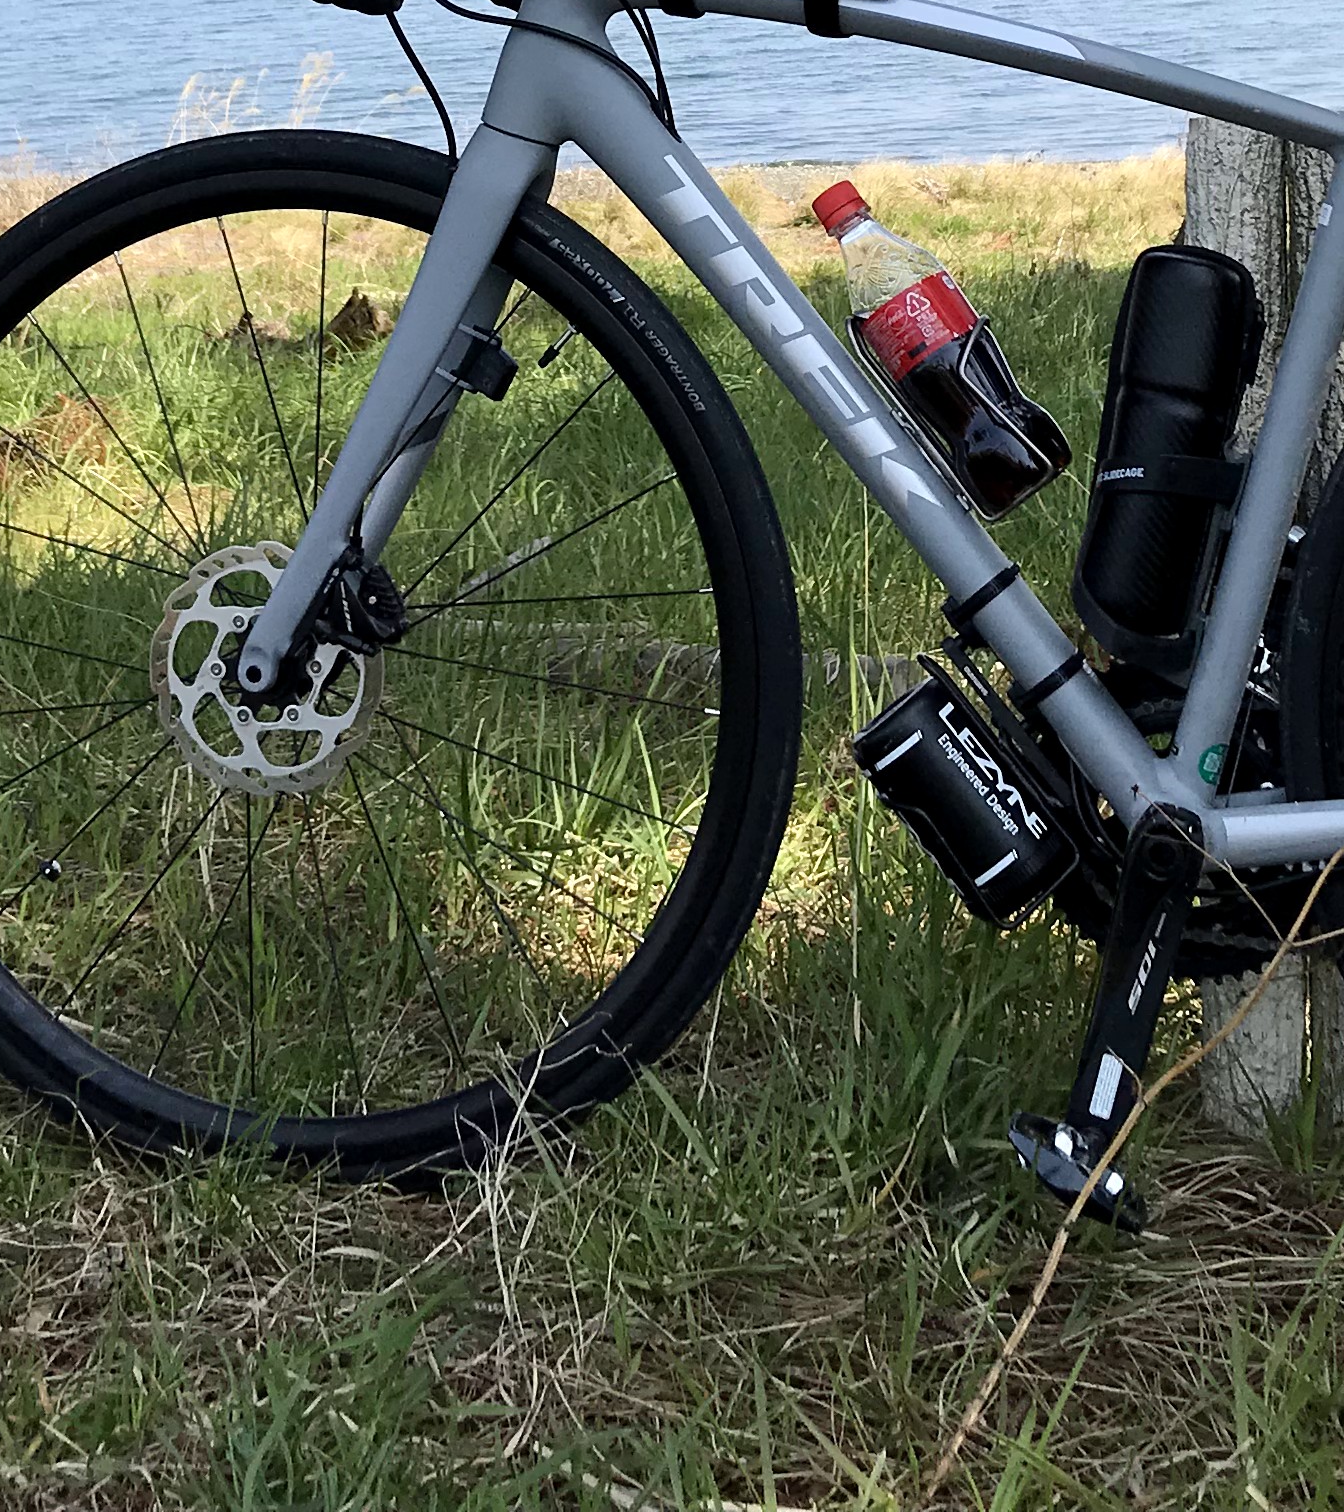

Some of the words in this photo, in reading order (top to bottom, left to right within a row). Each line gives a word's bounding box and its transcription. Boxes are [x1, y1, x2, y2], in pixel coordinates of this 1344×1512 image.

[623, 302, 647, 331] R1
[662, 154, 944, 508] TREK
[644, 329, 706, 413] BONTRAGER
[937, 733, 990, 797] Engineered
[985, 793, 1019, 836] Design
[938, 701, 1048, 840] LEZYNE
